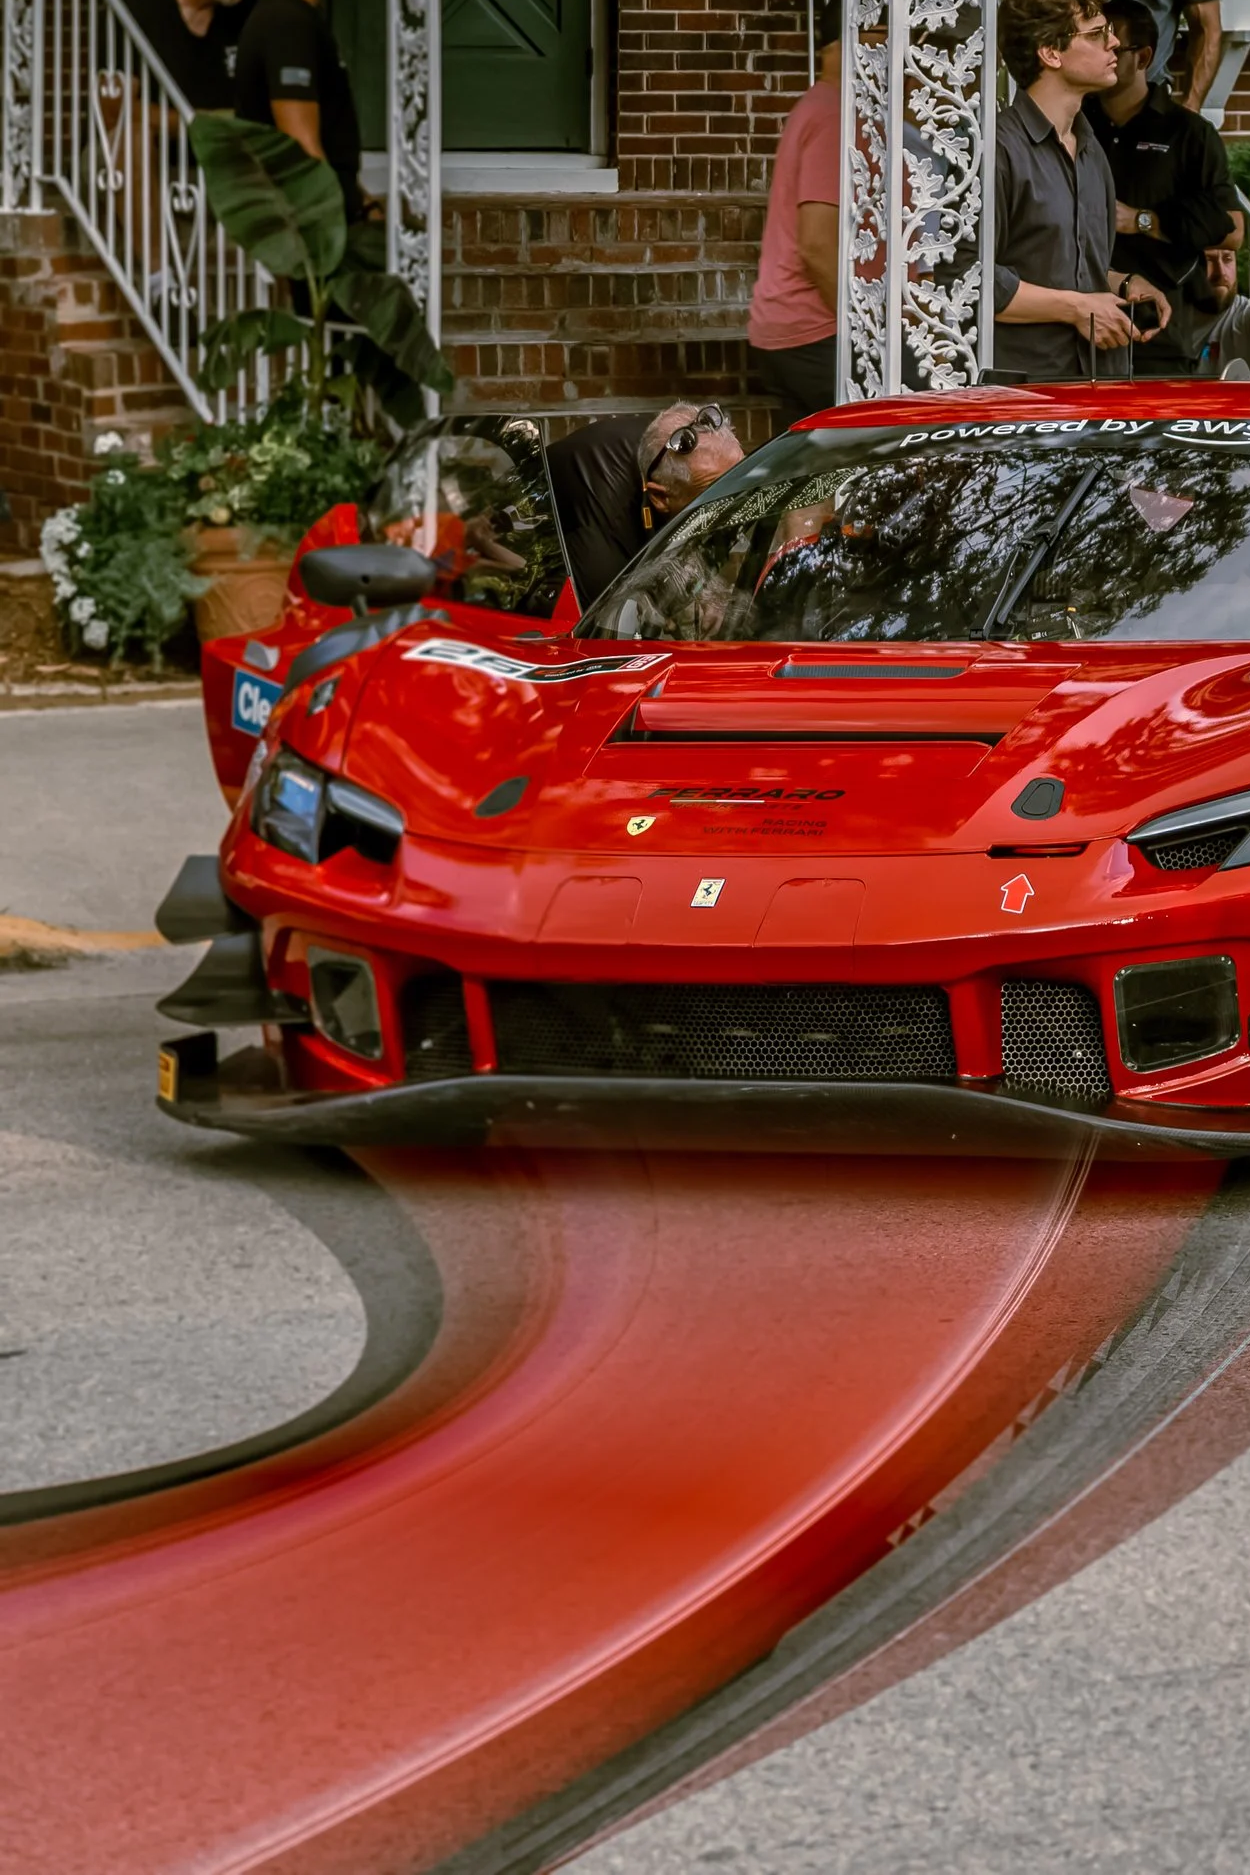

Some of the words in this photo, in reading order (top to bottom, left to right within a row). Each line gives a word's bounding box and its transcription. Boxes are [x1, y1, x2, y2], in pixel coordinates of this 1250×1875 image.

[899, 418, 1089, 447] powered
[1099, 418, 1154, 435] by
[238, 681, 273, 728] Cle
[646, 787, 846, 801] FERRARO
[762, 818, 828, 828] RACING
